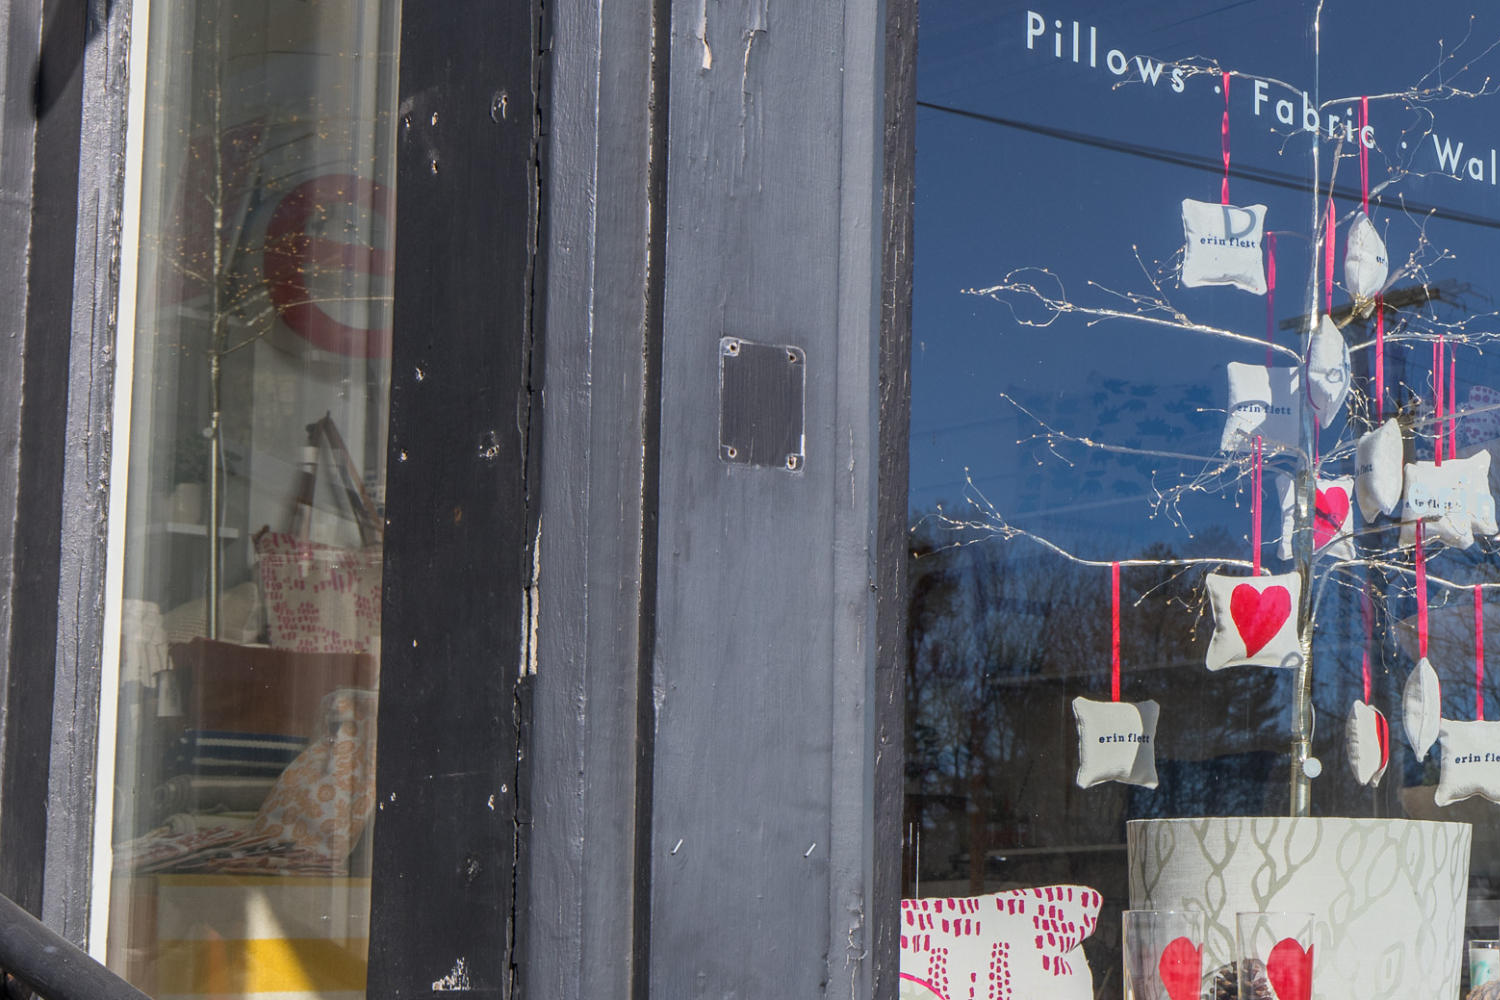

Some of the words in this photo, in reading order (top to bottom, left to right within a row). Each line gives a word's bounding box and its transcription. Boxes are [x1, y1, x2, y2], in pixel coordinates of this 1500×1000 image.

[1026, 10, 1185, 93] Pillows
[1254, 80, 1375, 149] Fabric
[1199, 235, 1226, 246] erin
[1229, 237, 1256, 249] flett
[1098, 733, 1125, 744] erin
[1127, 732, 1150, 744] flett
[1454, 753, 1482, 764] erin
